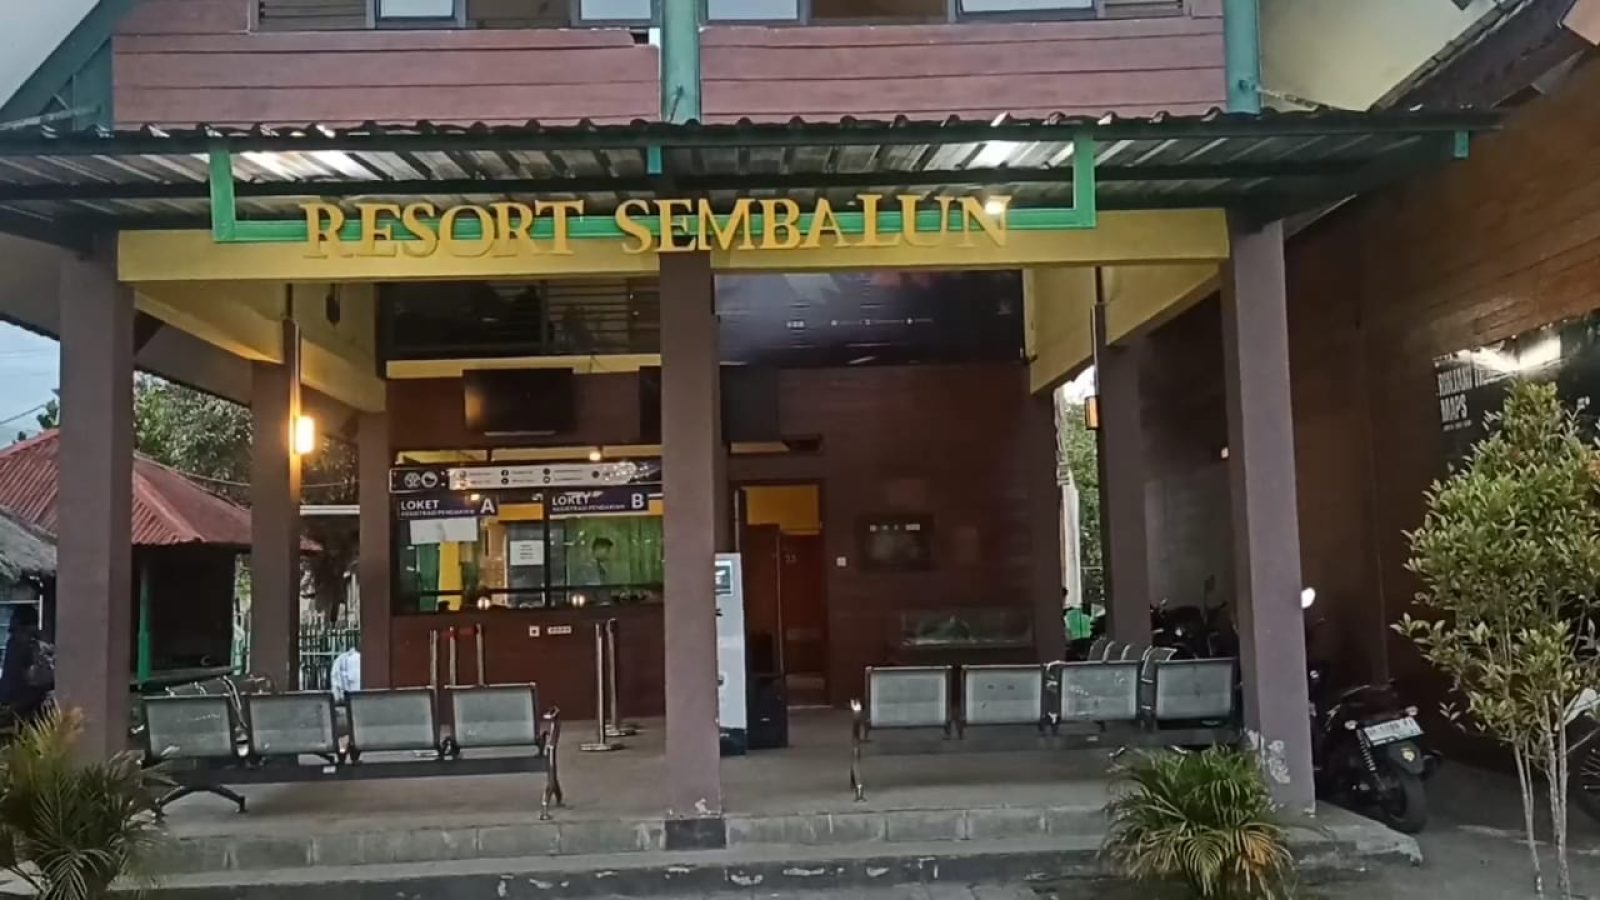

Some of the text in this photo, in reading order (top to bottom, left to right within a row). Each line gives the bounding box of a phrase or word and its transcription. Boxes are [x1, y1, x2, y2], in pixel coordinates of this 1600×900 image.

[299, 193, 1012, 258] RESORT SEMBALUN
[400, 499, 440, 511] LOKET
[480, 497, 496, 514] A
[551, 494, 591, 506] LOKET
[630, 492, 645, 509] B
